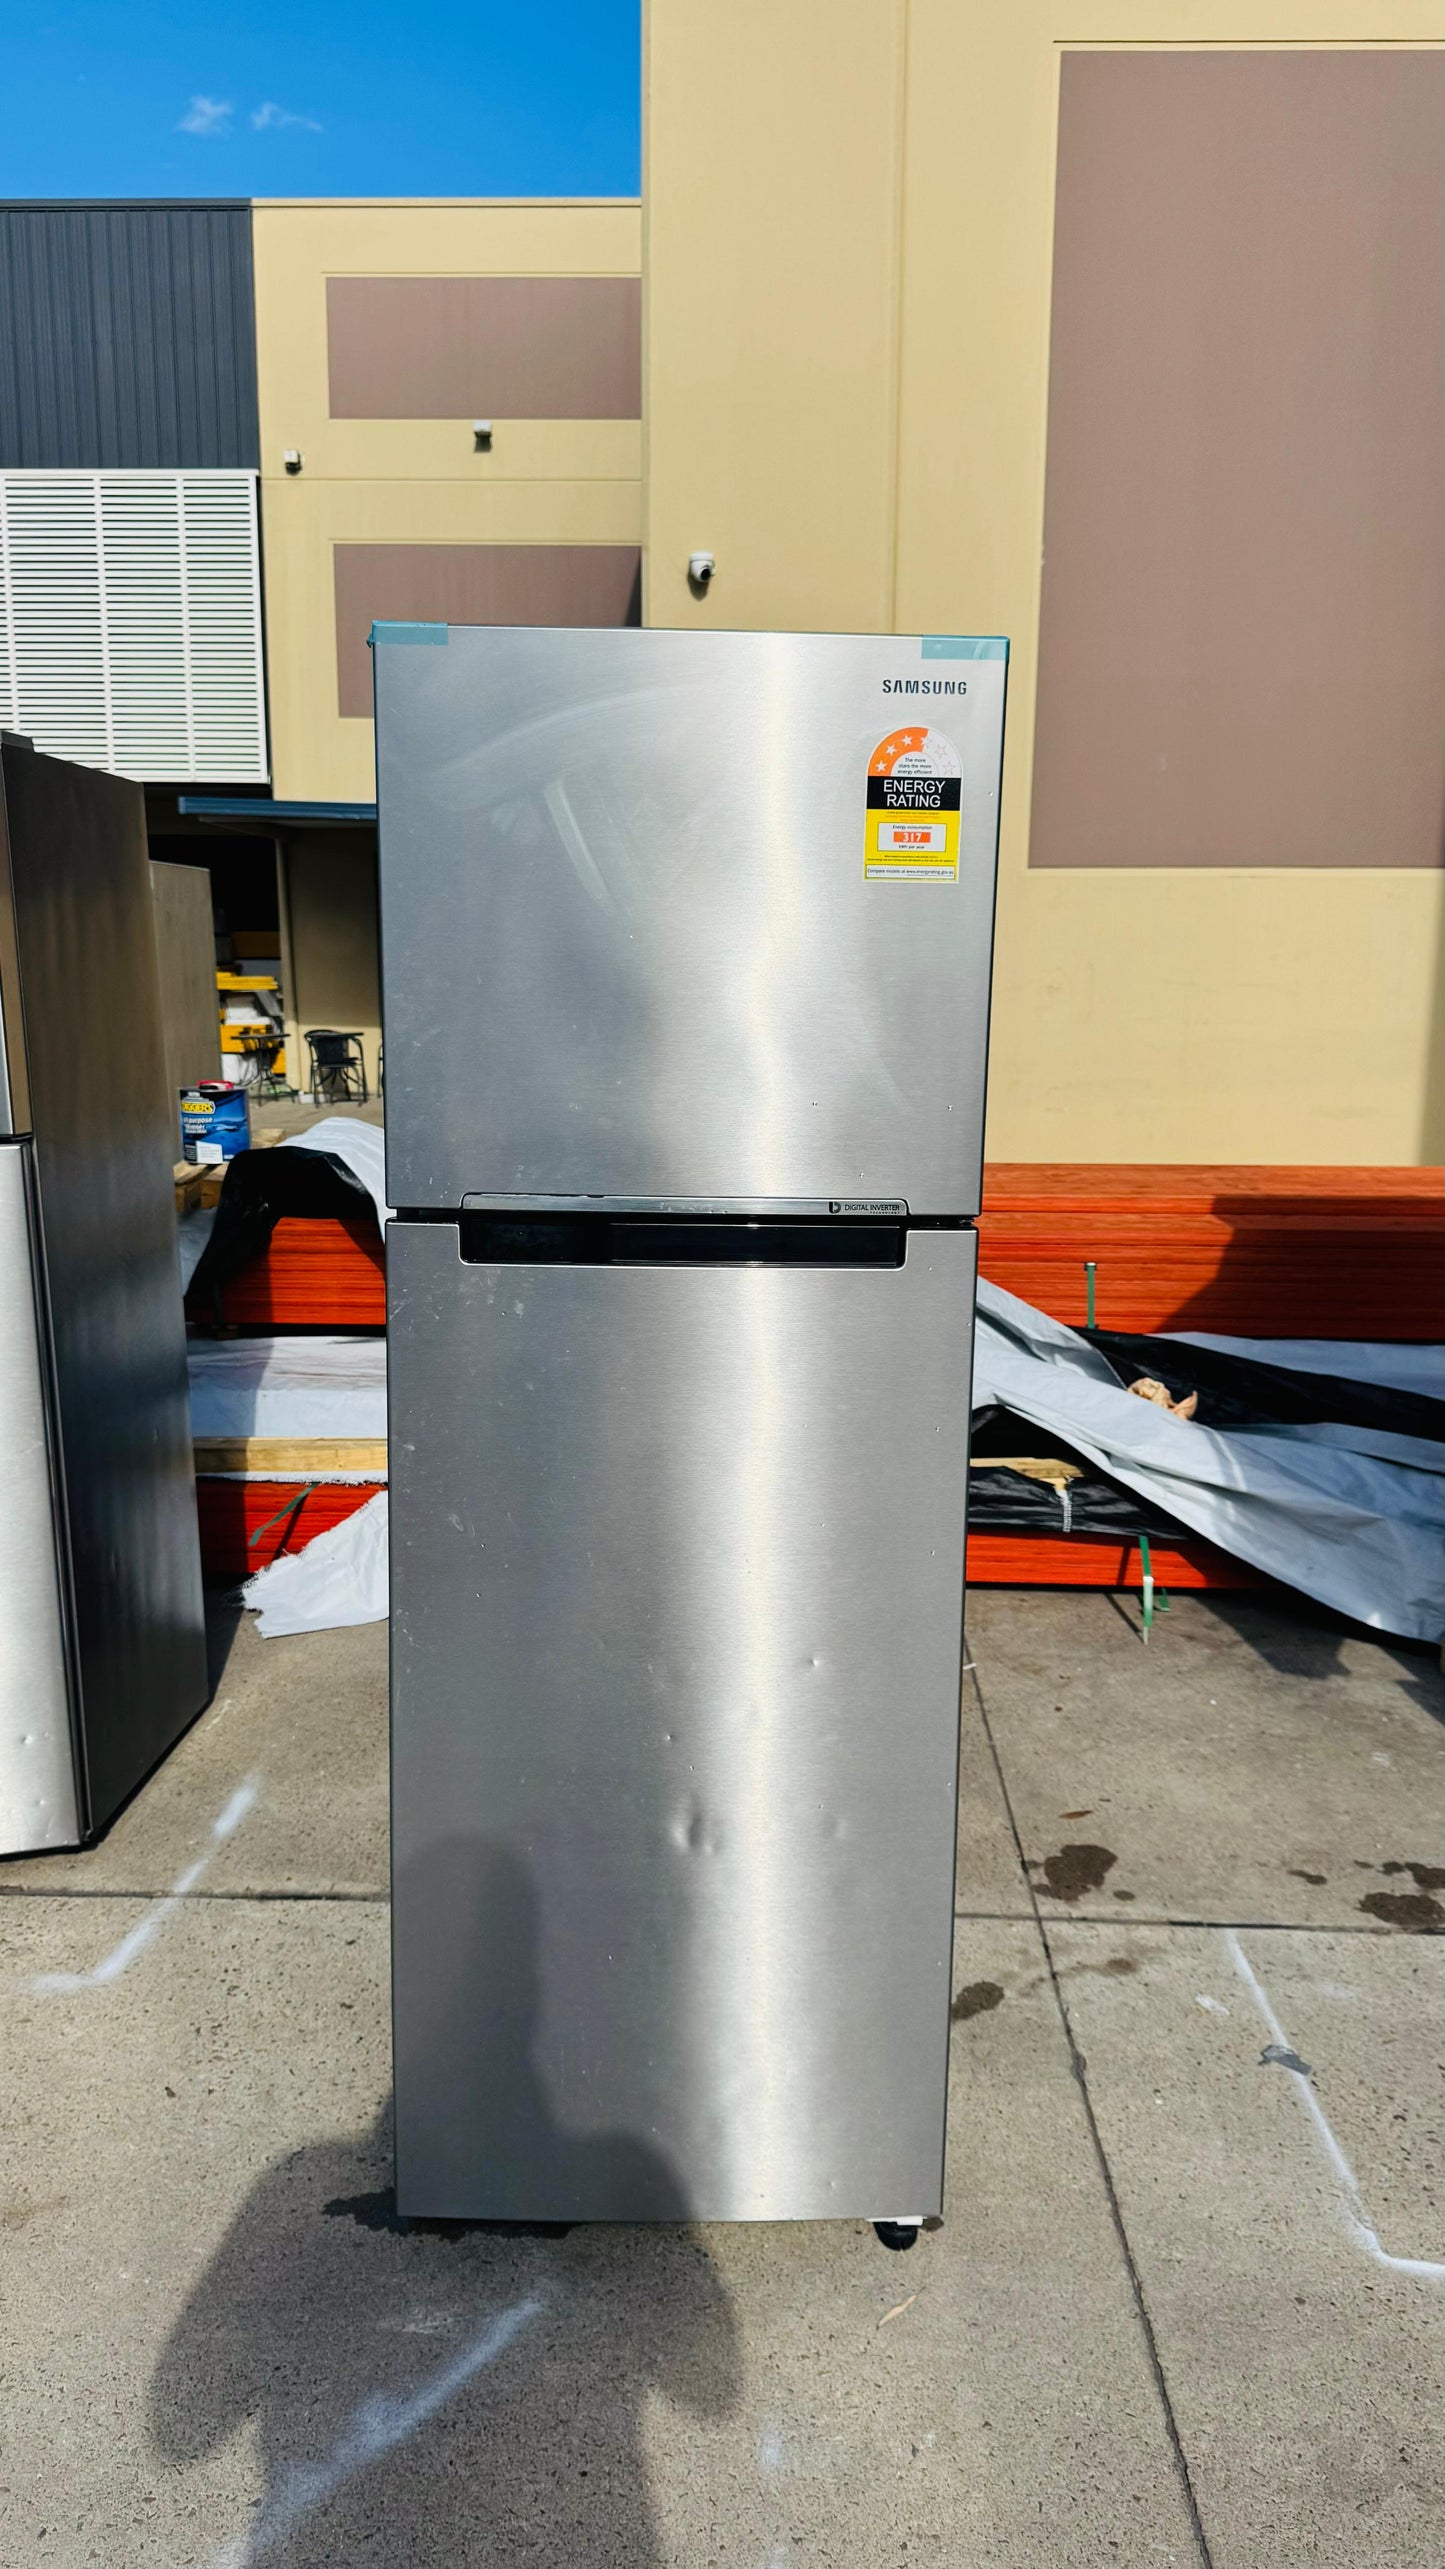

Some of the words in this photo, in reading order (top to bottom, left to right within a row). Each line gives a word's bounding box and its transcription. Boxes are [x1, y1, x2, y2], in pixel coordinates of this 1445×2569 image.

[882, 679, 967, 695] SAMSUNG
[883, 779, 946, 793] ENERGY
[886, 793, 941, 808] RATING
[903, 832, 922, 842] 317
